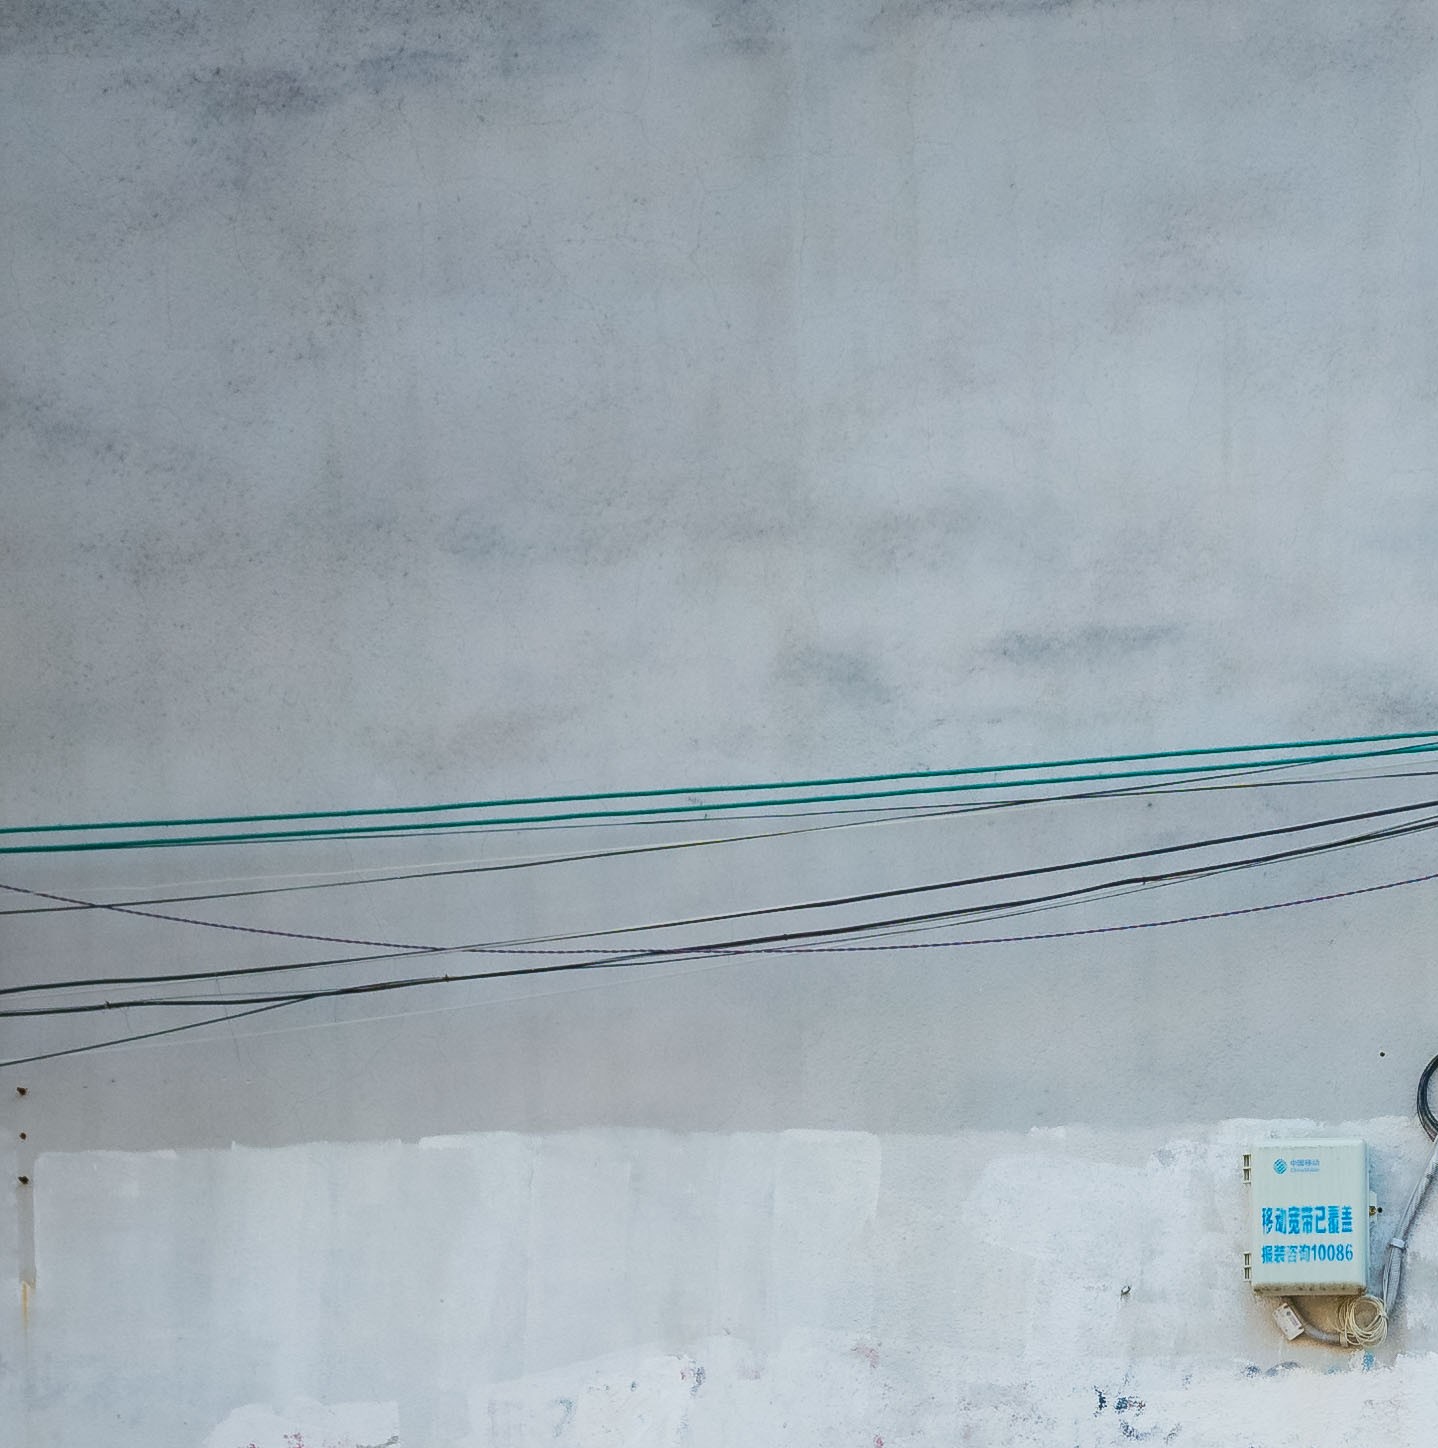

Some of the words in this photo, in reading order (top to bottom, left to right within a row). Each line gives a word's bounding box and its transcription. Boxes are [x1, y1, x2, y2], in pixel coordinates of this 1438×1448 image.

[1261, 1205, 1353, 1235] 移动宽带已覆盖
[1261, 1244, 1354, 1264] 报装咨询10086
